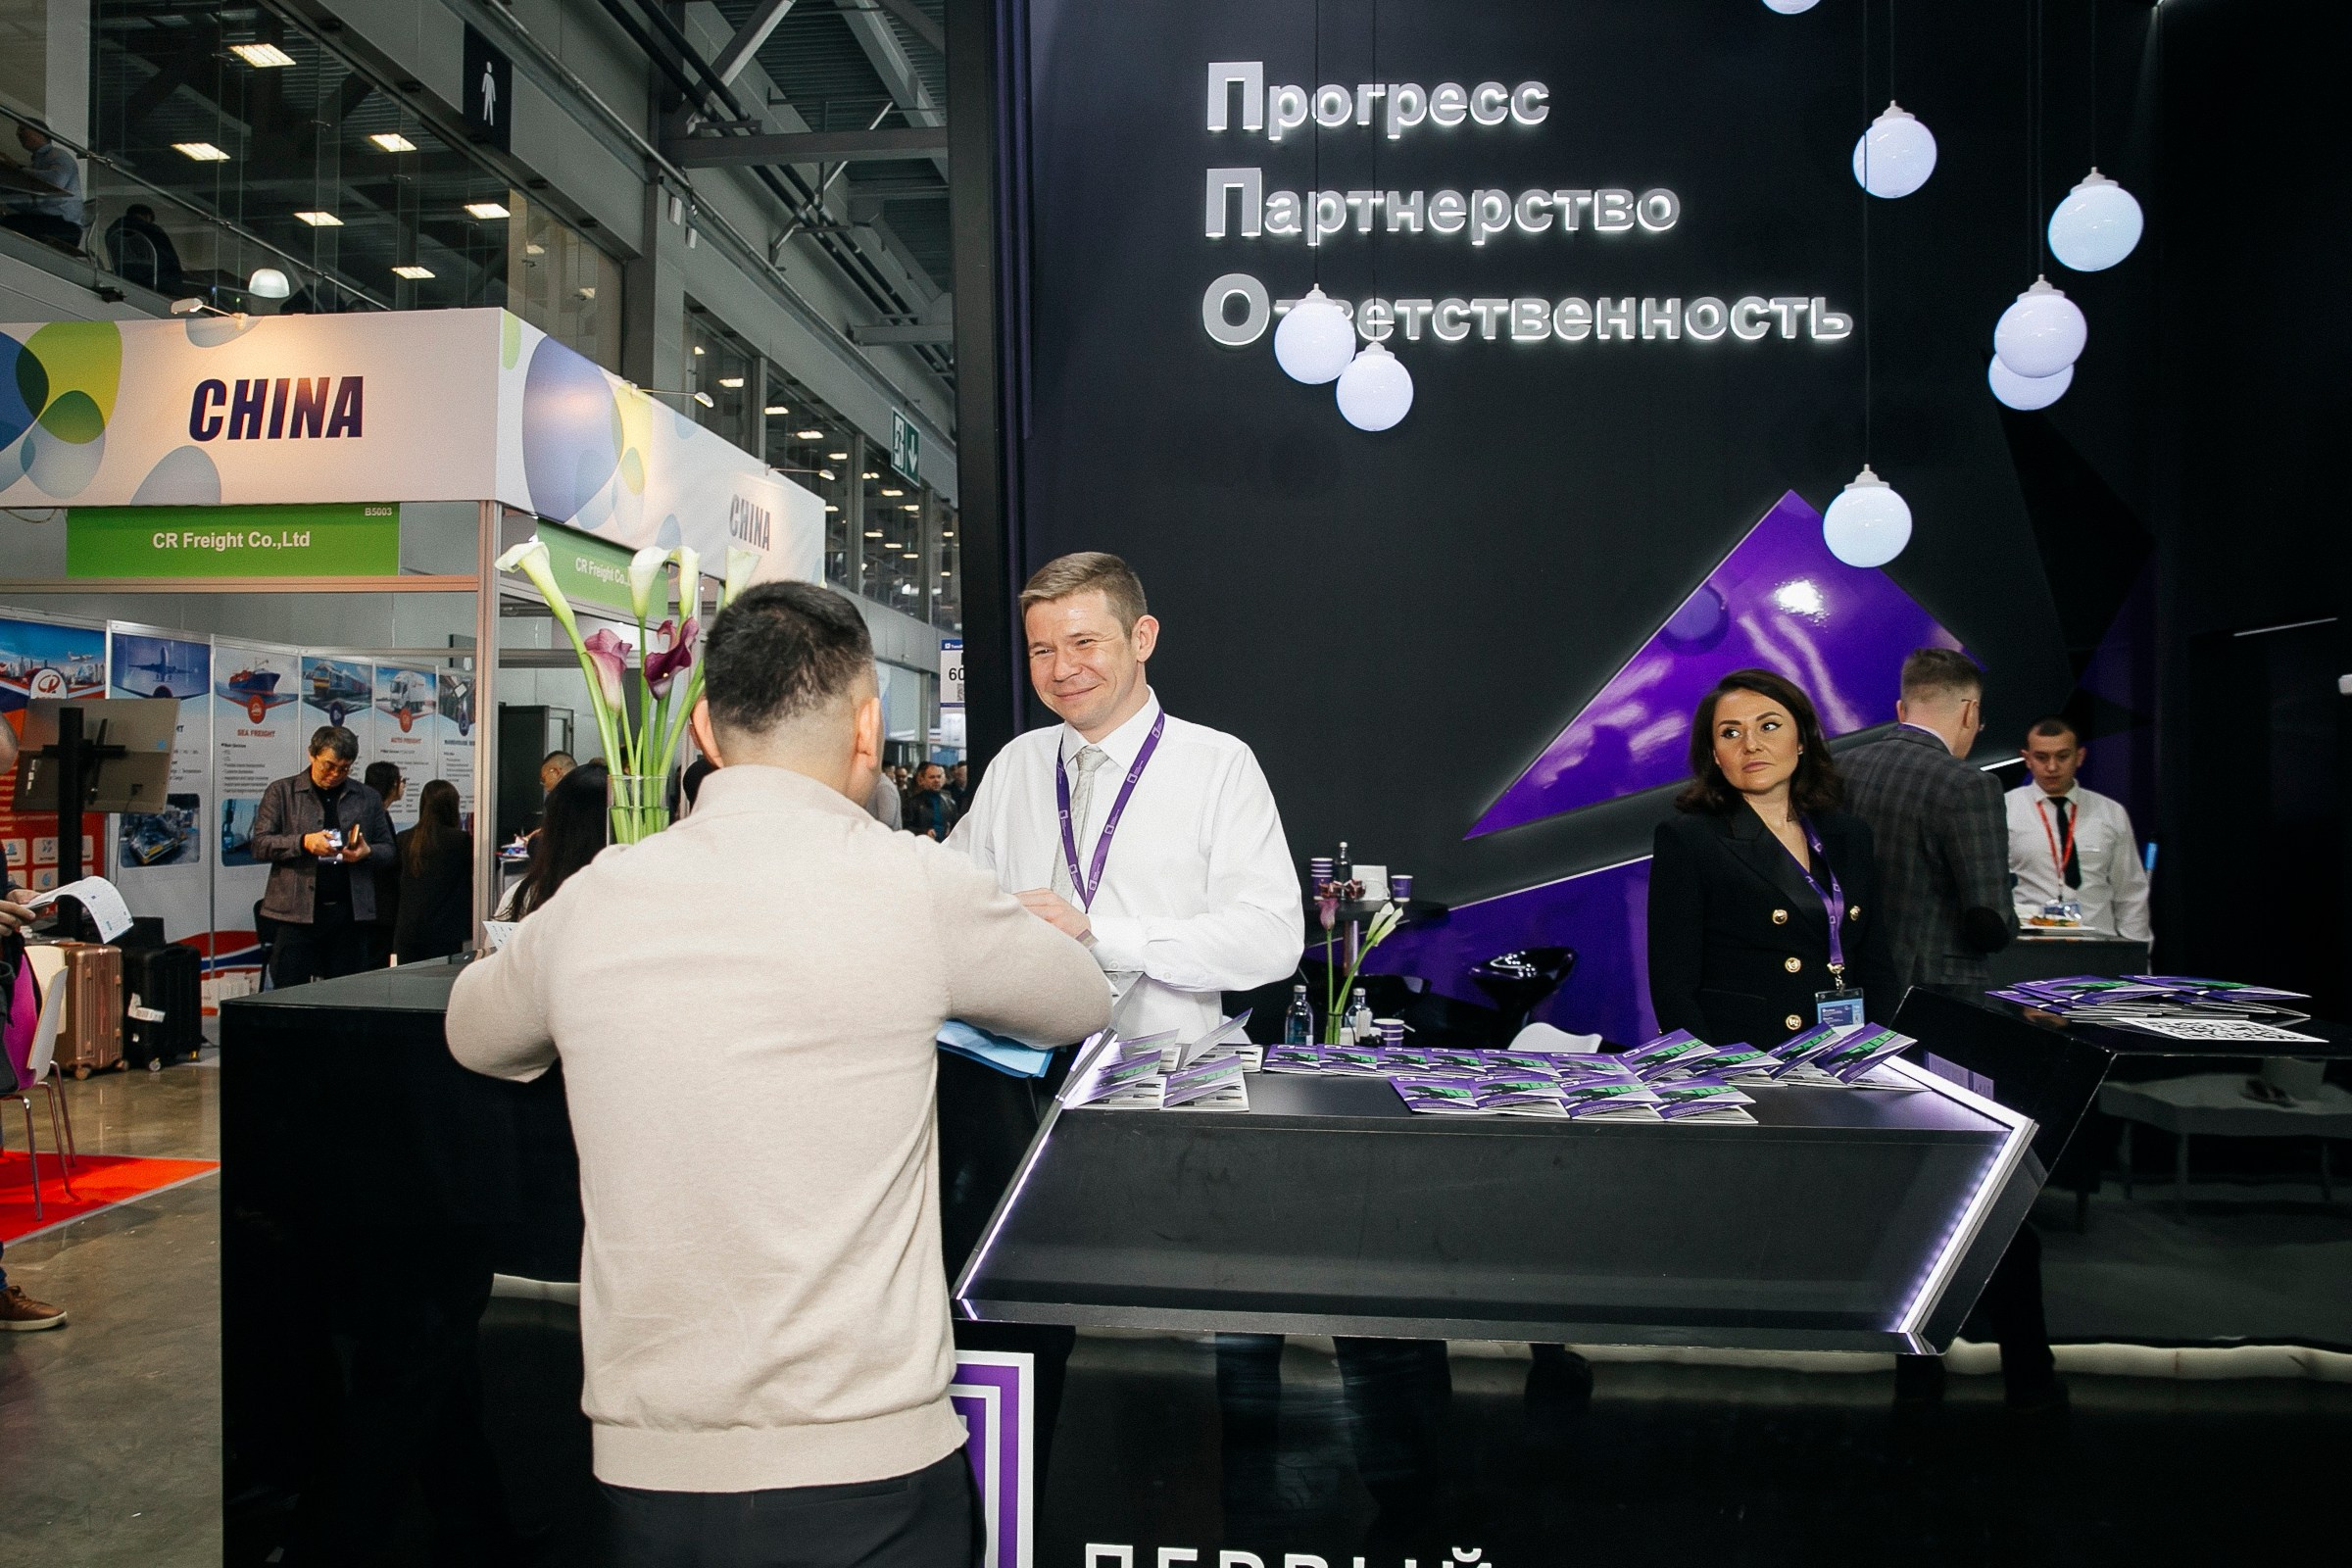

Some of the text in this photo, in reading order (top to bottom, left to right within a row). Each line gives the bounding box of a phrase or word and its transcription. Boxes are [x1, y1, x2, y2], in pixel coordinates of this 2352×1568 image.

[1206, 61, 1550, 140] Прогресс
[1205, 167, 1681, 247] Партнерство
[1201, 272, 1853, 346] Оетственность
[189, 375, 364, 441] CHINA
[153, 530, 311, 552] CR Freight Co.,Ltd
[365, 507, 392, 516] B5003
[729, 493, 771, 552] CHINA
[575, 557, 588, 573] CR
[588, 561, 614, 583] Freight
